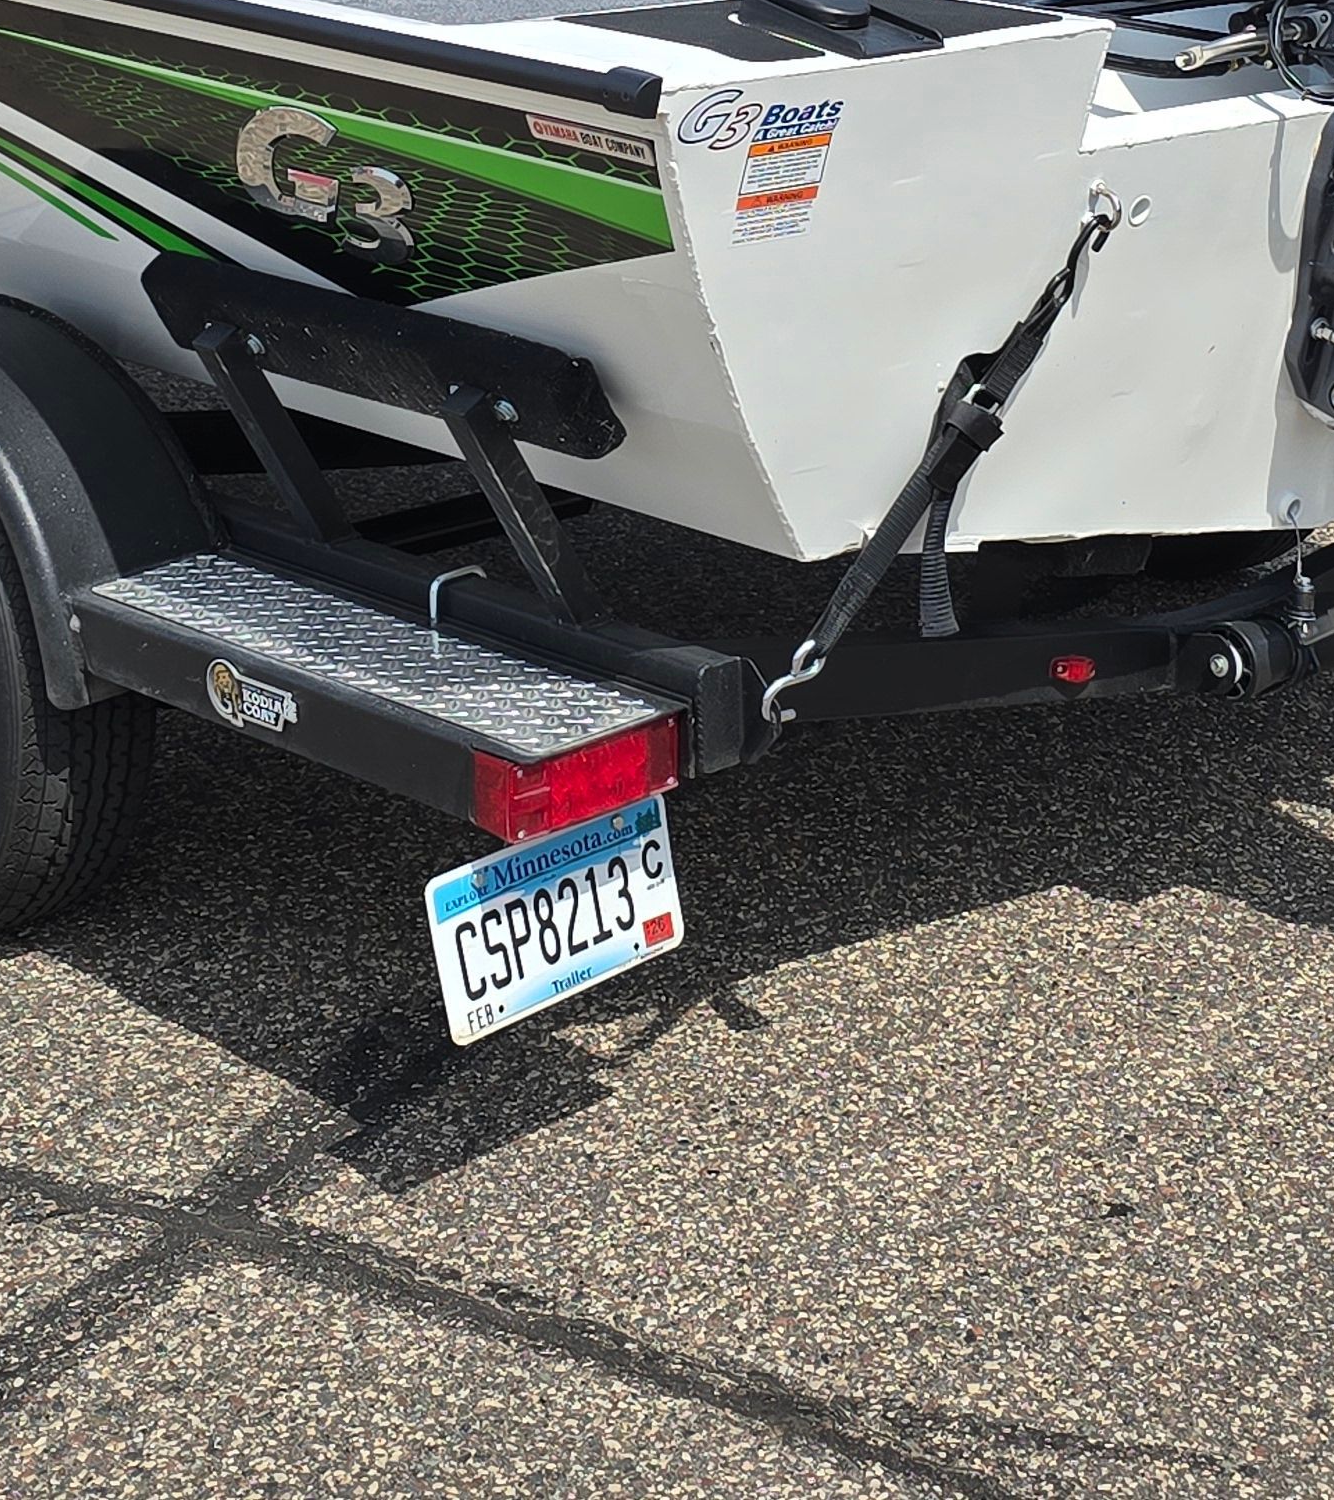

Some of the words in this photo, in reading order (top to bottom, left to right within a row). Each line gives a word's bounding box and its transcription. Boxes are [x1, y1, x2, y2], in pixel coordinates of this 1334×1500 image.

[677, 89, 763, 151] G3
[761, 99, 845, 128] Boats
[754, 128, 764, 140] A
[766, 125, 798, 139] Great
[542, 122, 581, 143] YAMAHA
[580, 131, 604, 149] BOAT
[605, 137, 647, 160] COMPANY
[236, 105, 415, 265] G3
[492, 825, 634, 891] Minnesota.com
[641, 839, 664, 879] C
[455, 855, 636, 1001] CSP8213
[551, 966, 594, 994] Trailer
[468, 1003, 495, 1035] FEB
